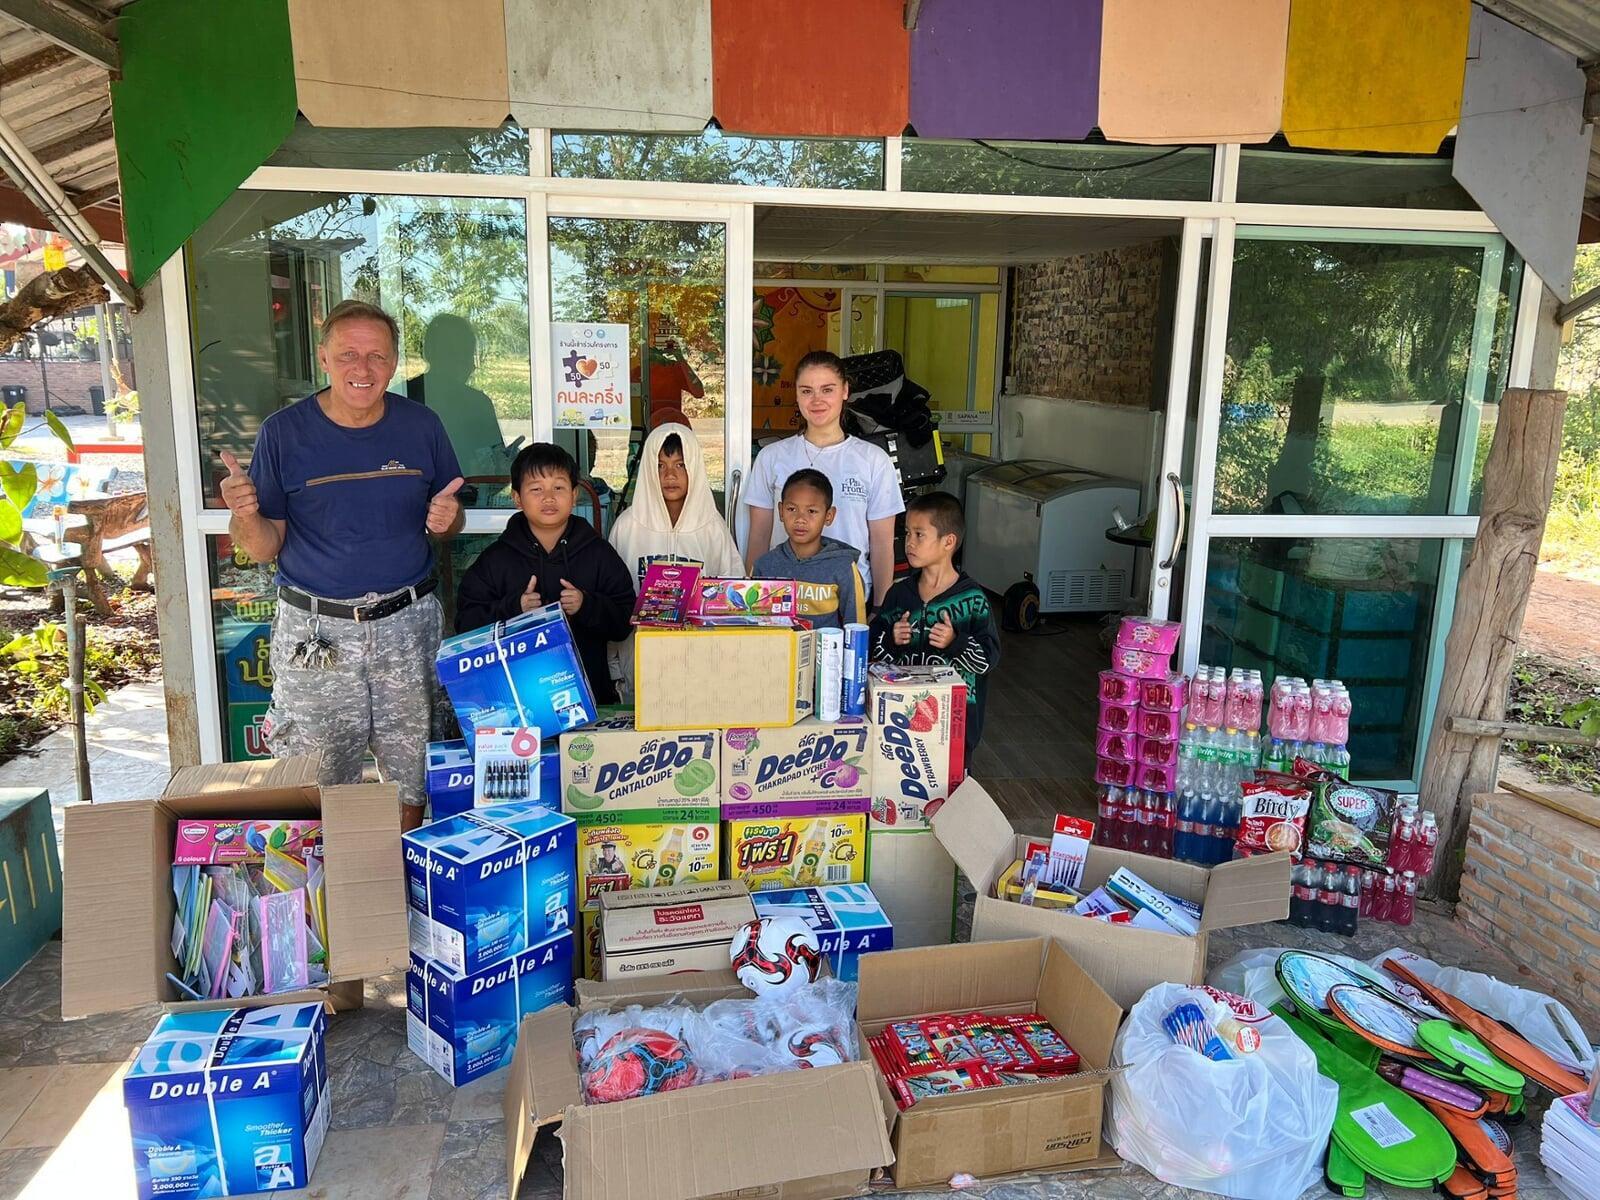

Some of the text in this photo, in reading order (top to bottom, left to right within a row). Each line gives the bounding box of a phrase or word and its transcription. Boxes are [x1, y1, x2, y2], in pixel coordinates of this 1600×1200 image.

[570, 372, 581, 380] 50
[600, 362, 611, 370] 50
[557, 383, 624, 404] คนละครึ่ง
[458, 640, 527, 673] Double
[511, 727, 538, 757] 6
[594, 741, 693, 793] DeeDo
[755, 735, 848, 785] DeeDo
[883, 712, 929, 800] DeeDo
[914, 737, 938, 788] STRAWBERRY
[609, 768, 673, 800] CANTALOUPE
[757, 762, 827, 793] CHAKRAPAD LYCHEE
[752, 805, 772, 815] 450
[832, 801, 846, 811] 24
[1254, 797, 1300, 823] Birdy
[1337, 796, 1368, 810] SUPER
[595, 813, 617, 824] 450
[680, 810, 694, 821] 24
[831, 828, 842, 838] 10
[406, 847, 443, 875] Double
[480, 845, 540, 880] Double
[688, 862, 701, 872] 10
[1146, 895, 1172, 915] 300
[471, 957, 535, 995] Double
[149, 1074, 243, 1100] Double
[245, 1122, 284, 1132] Smoother
[260, 1128, 293, 1136] Thicker
